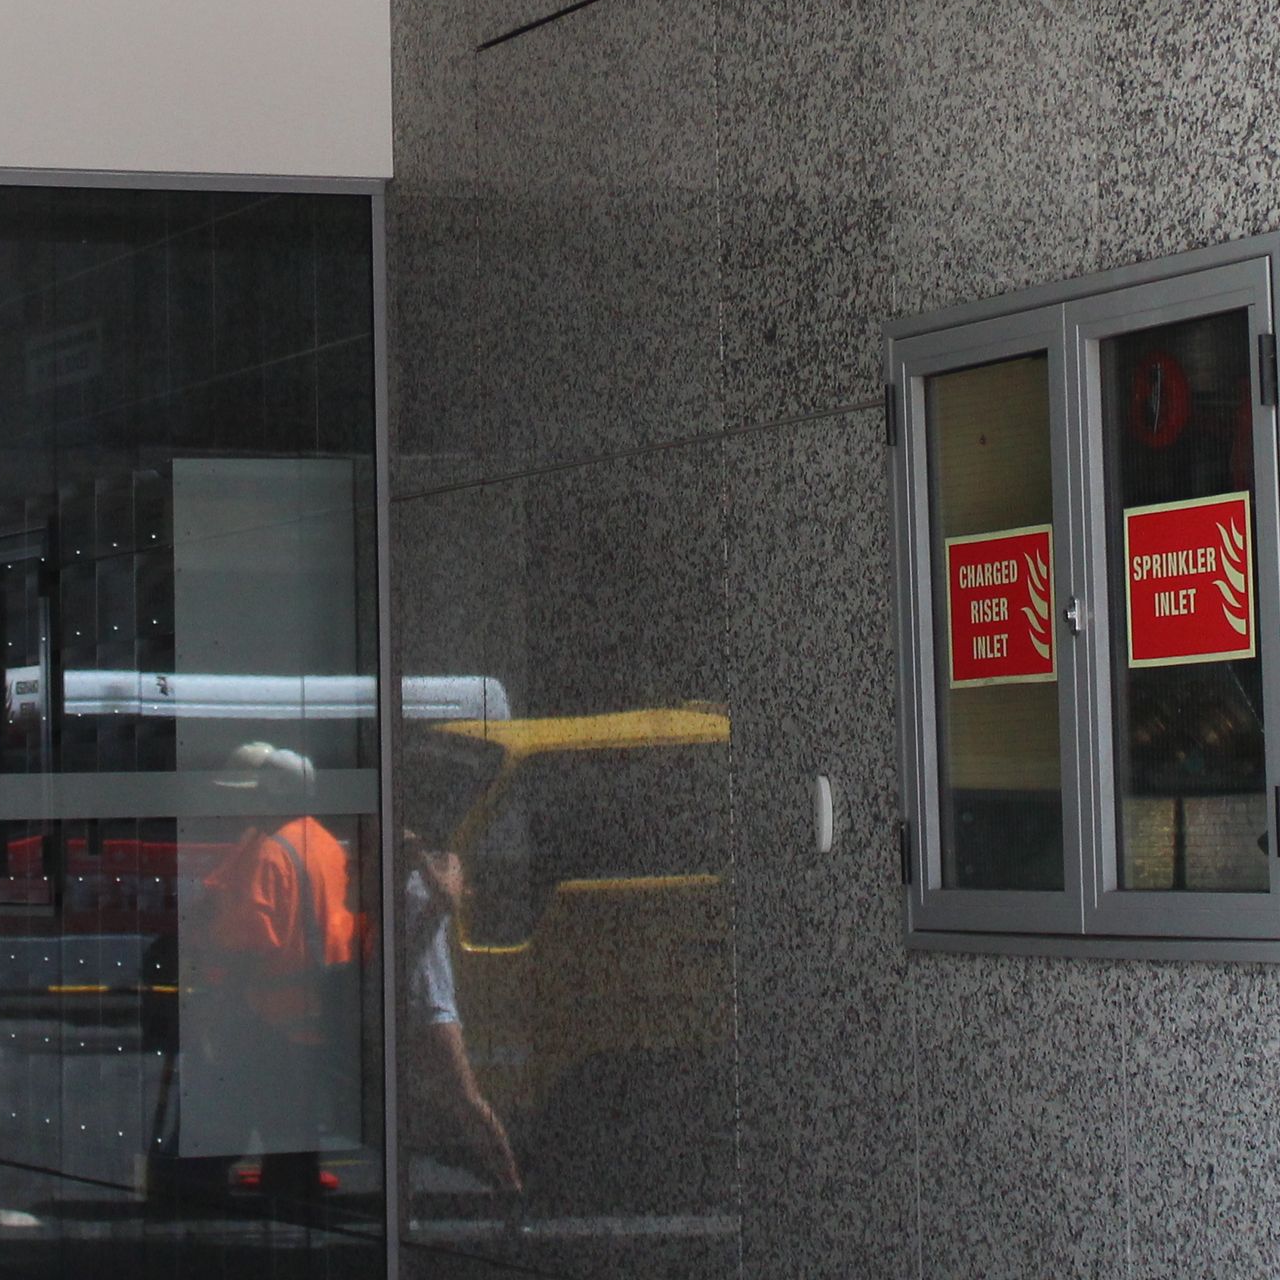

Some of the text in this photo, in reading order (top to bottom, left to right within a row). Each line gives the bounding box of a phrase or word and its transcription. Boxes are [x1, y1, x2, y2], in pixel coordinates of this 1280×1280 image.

[959, 559, 1019, 589] CHARGED
[1132, 546, 1217, 582] SPRINKLER
[970, 597, 1009, 624] RISER
[1154, 588, 1197, 617] INLET
[972, 633, 1009, 660] INLET
